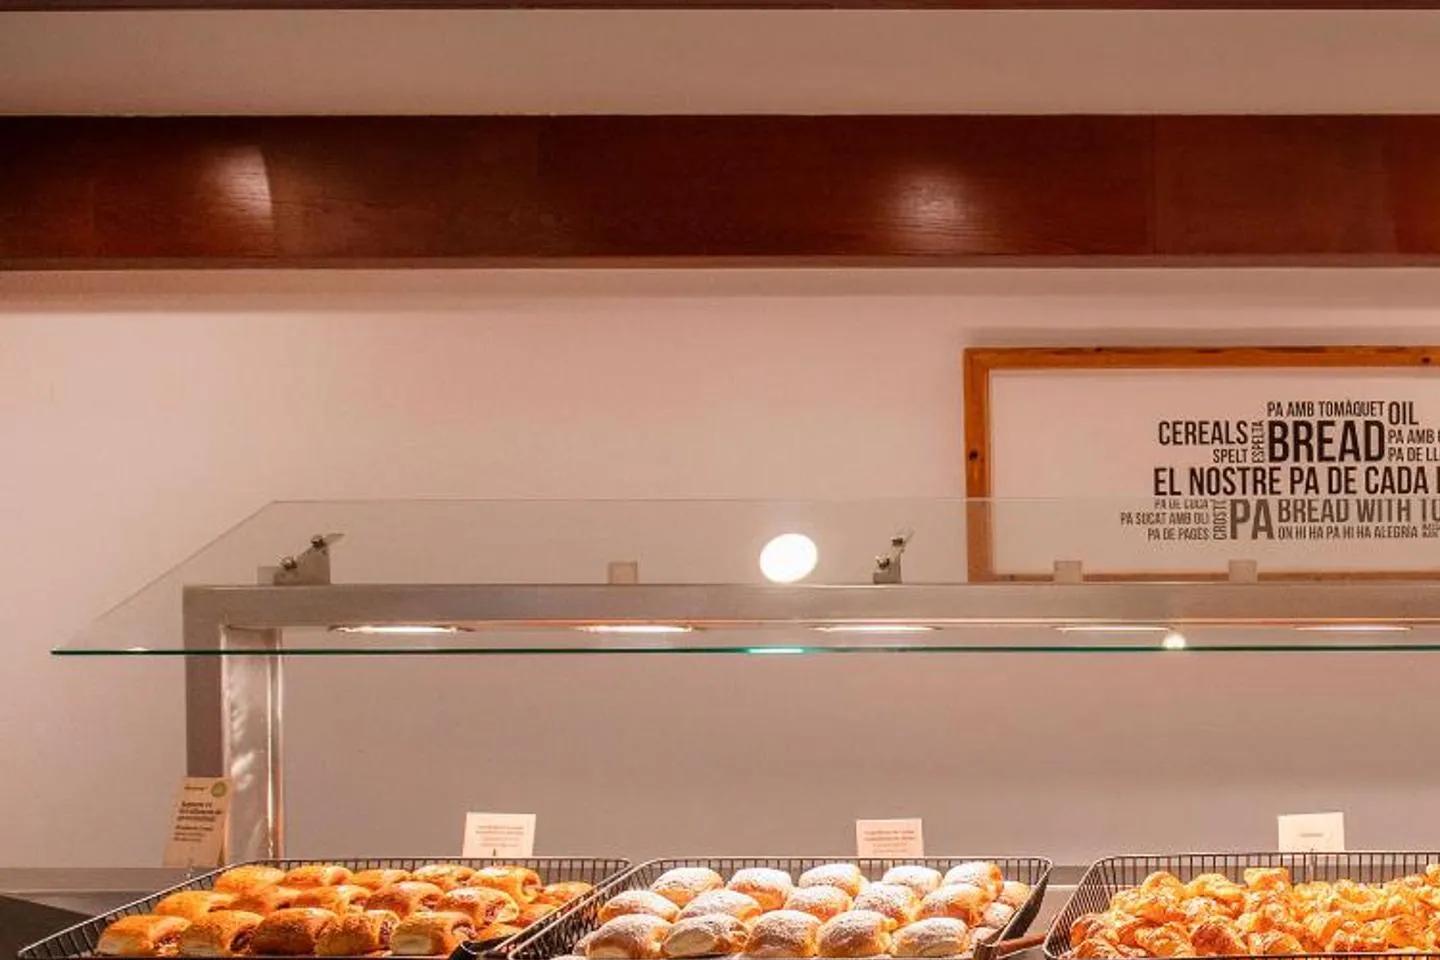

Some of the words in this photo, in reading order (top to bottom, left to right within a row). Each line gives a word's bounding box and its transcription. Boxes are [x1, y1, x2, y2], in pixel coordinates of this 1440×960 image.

[1267, 402, 1282, 416] PA
[1286, 402, 1314, 416] AMB
[1388, 401, 1419, 425] OIL
[1158, 421, 1248, 445] CEREALS
[1388, 429, 1403, 444] PA
[1407, 429, 1434, 444] AMB
[1268, 420, 1384, 463] BREAD
[1213, 448, 1248, 463] SPELT
[1388, 447, 1403, 461] PA
[1407, 447, 1422, 461] DE
[1154, 467, 1181, 496] EL
[1189, 467, 1281, 496] NOSTRE
[1290, 467, 1319, 495] PA
[1328, 466, 1357, 495] DE
[1364, 466, 1429, 495] CADA
[1120, 512, 1134, 525] PA
[1169, 512, 1192, 525] AMB
[1278, 499, 1349, 523] BREAD
[1356, 499, 1411, 523] WITH
[1230, 499, 1275, 540] PA
[1148, 528, 1161, 540] PA
[1163, 528, 1176, 540] DE
[1295, 526, 1306, 539] HI
[1309, 526, 1324, 539] HA
[1326, 526, 1341, 539] PA
[1343, 526, 1354, 539] HI
[1356, 525, 1372, 539] HA
[1374, 525, 1418, 539] ALEGRIA
